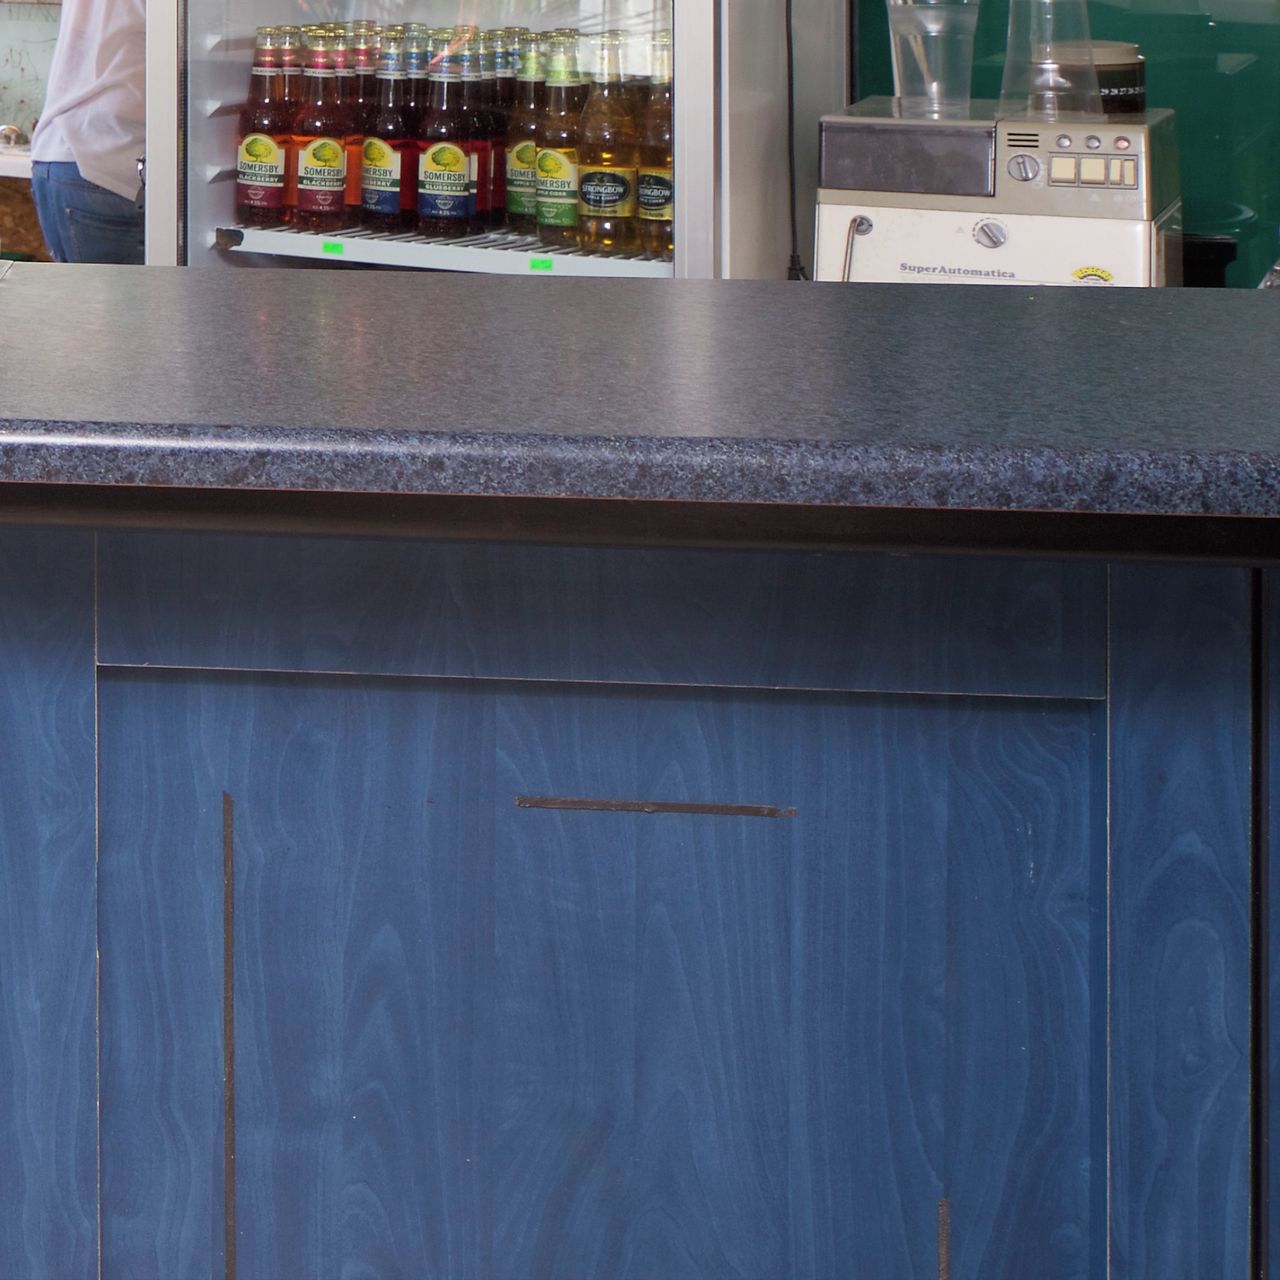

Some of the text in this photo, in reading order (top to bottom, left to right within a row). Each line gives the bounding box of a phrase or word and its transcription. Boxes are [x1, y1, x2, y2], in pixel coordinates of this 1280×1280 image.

[239, 160, 280, 173] SOMERSBY
[423, 170, 466, 182] SOMERSBY
[510, 168, 537, 179] SOMER
[582, 184, 625, 194] STRONGBOW
[899, 262, 1017, 280] SuperAutomatica
